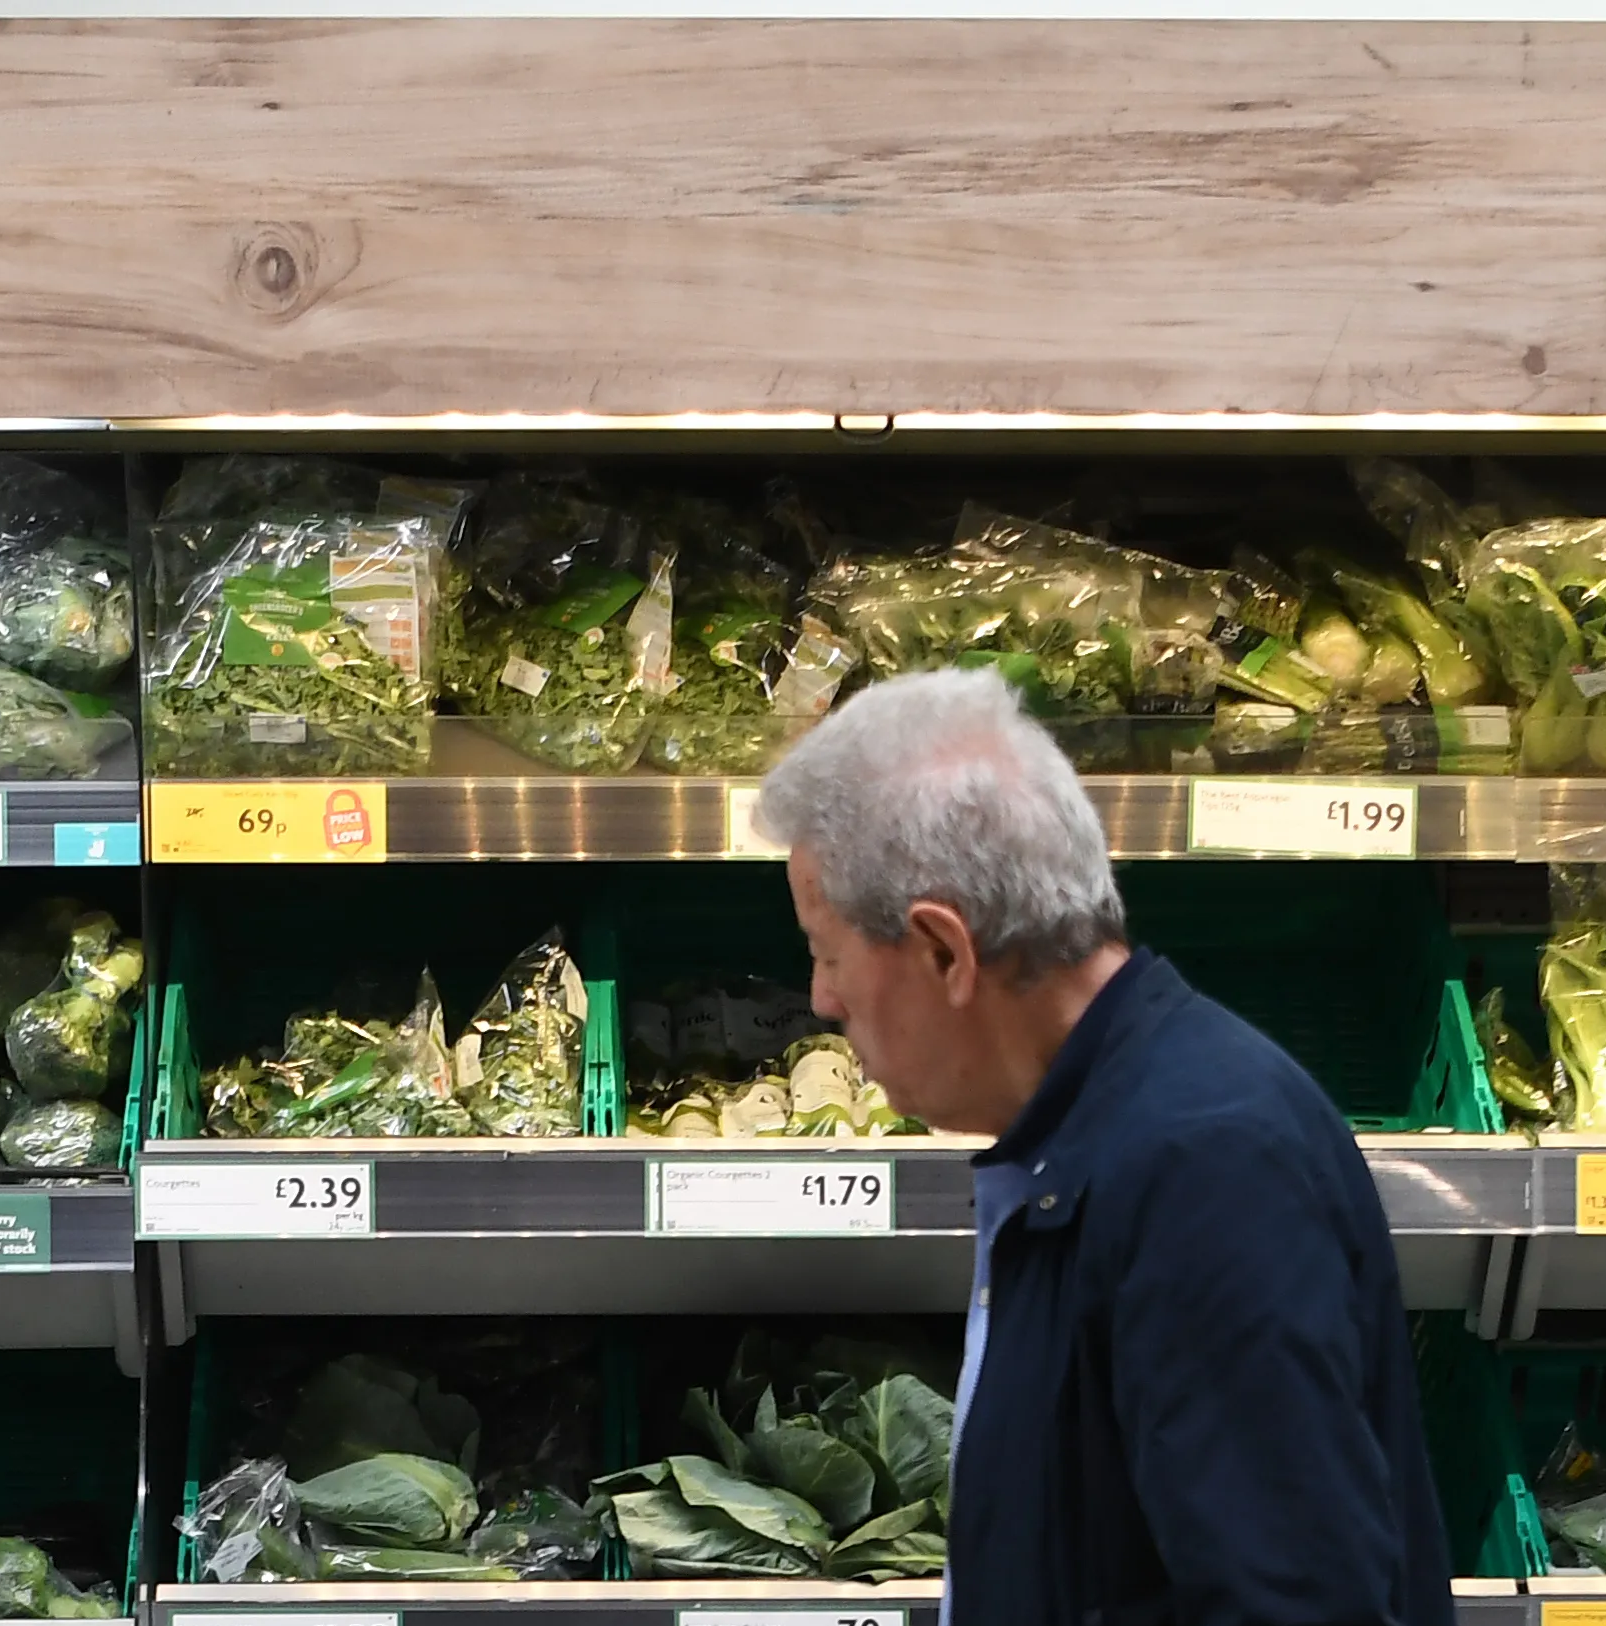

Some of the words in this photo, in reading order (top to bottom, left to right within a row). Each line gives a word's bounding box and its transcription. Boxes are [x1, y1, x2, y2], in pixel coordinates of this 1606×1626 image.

[239, 809, 286, 834] 69p
[1328, 801, 1404, 831] £1.99
[146, 1179, 201, 1191] Courgettes
[666, 1169, 706, 1182] Organic
[709, 1169, 761, 1182] Courgettes
[276, 1178, 361, 1208] £2.39
[803, 1175, 880, 1205] £1.79
[335, 1212, 351, 1222] per
[353, 1210, 364, 1222] kg
[3, 1241, 36, 1254] stock
